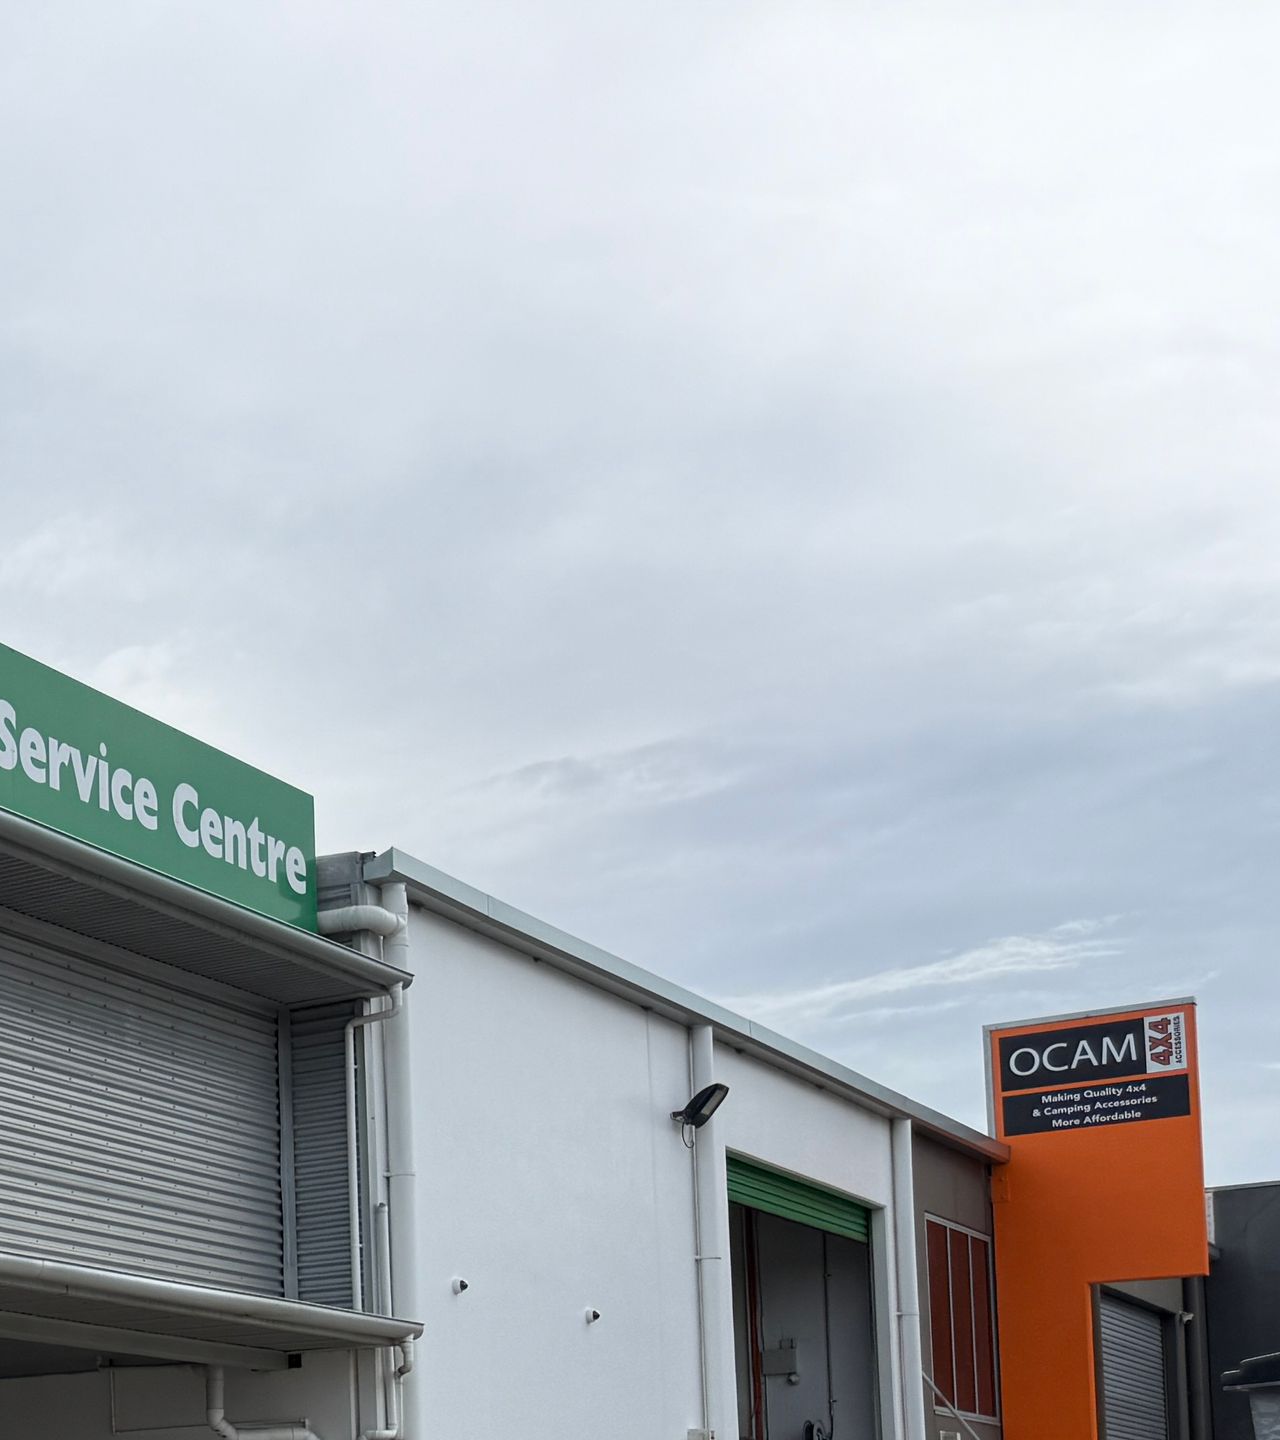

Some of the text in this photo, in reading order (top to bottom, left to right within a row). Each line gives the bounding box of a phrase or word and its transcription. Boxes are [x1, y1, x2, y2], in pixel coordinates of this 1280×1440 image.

[174, 781, 308, 895] Centre
[1009, 1034, 1138, 1076] OCAM
[1174, 1016, 1182, 1064] ACCESSORIES
[1032, 1095, 1158, 1118] & Camping Accessories
[1042, 1083, 1146, 1104] Making Quality 4x4
[1052, 1110, 1142, 1128] More Affordable
